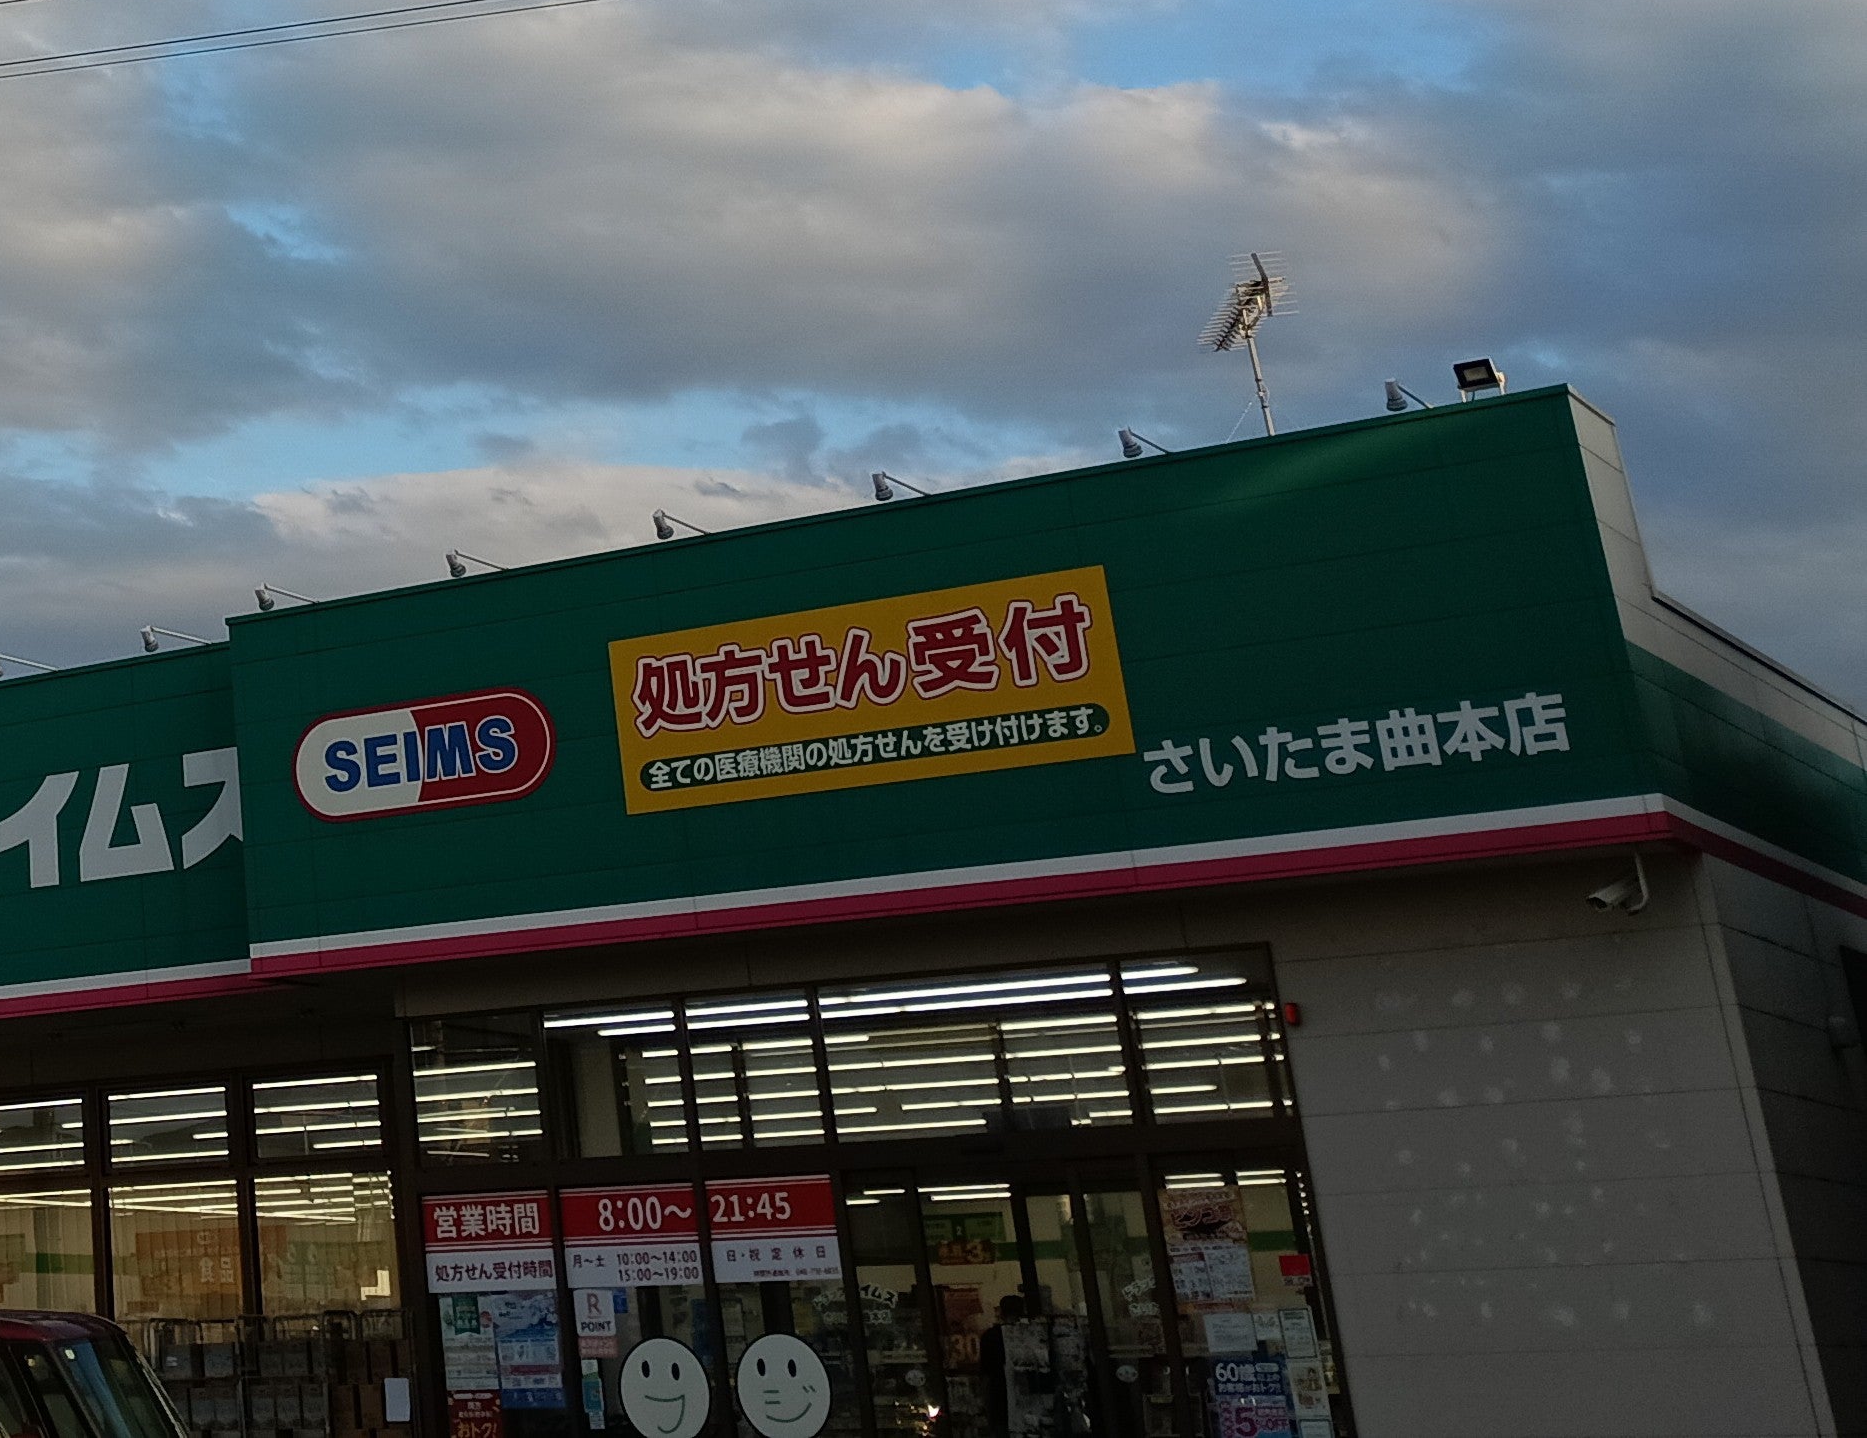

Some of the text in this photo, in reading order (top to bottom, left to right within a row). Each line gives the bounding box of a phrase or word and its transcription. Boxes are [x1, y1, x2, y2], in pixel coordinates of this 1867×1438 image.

[635, 593, 1092, 735] 処方せん受付
[324, 716, 517, 793] SEIMS
[647, 708, 1106, 791] 全ての医療機関の処方せんを受け付けます。
[1142, 692, 1572, 796] さいたま曲本店
[434, 1201, 540, 1240] 営業時間
[711, 1192, 792, 1223] 21:45
[435, 1259, 554, 1283] 処方せん受付時間
[581, 1320, 611, 1333] POINT
